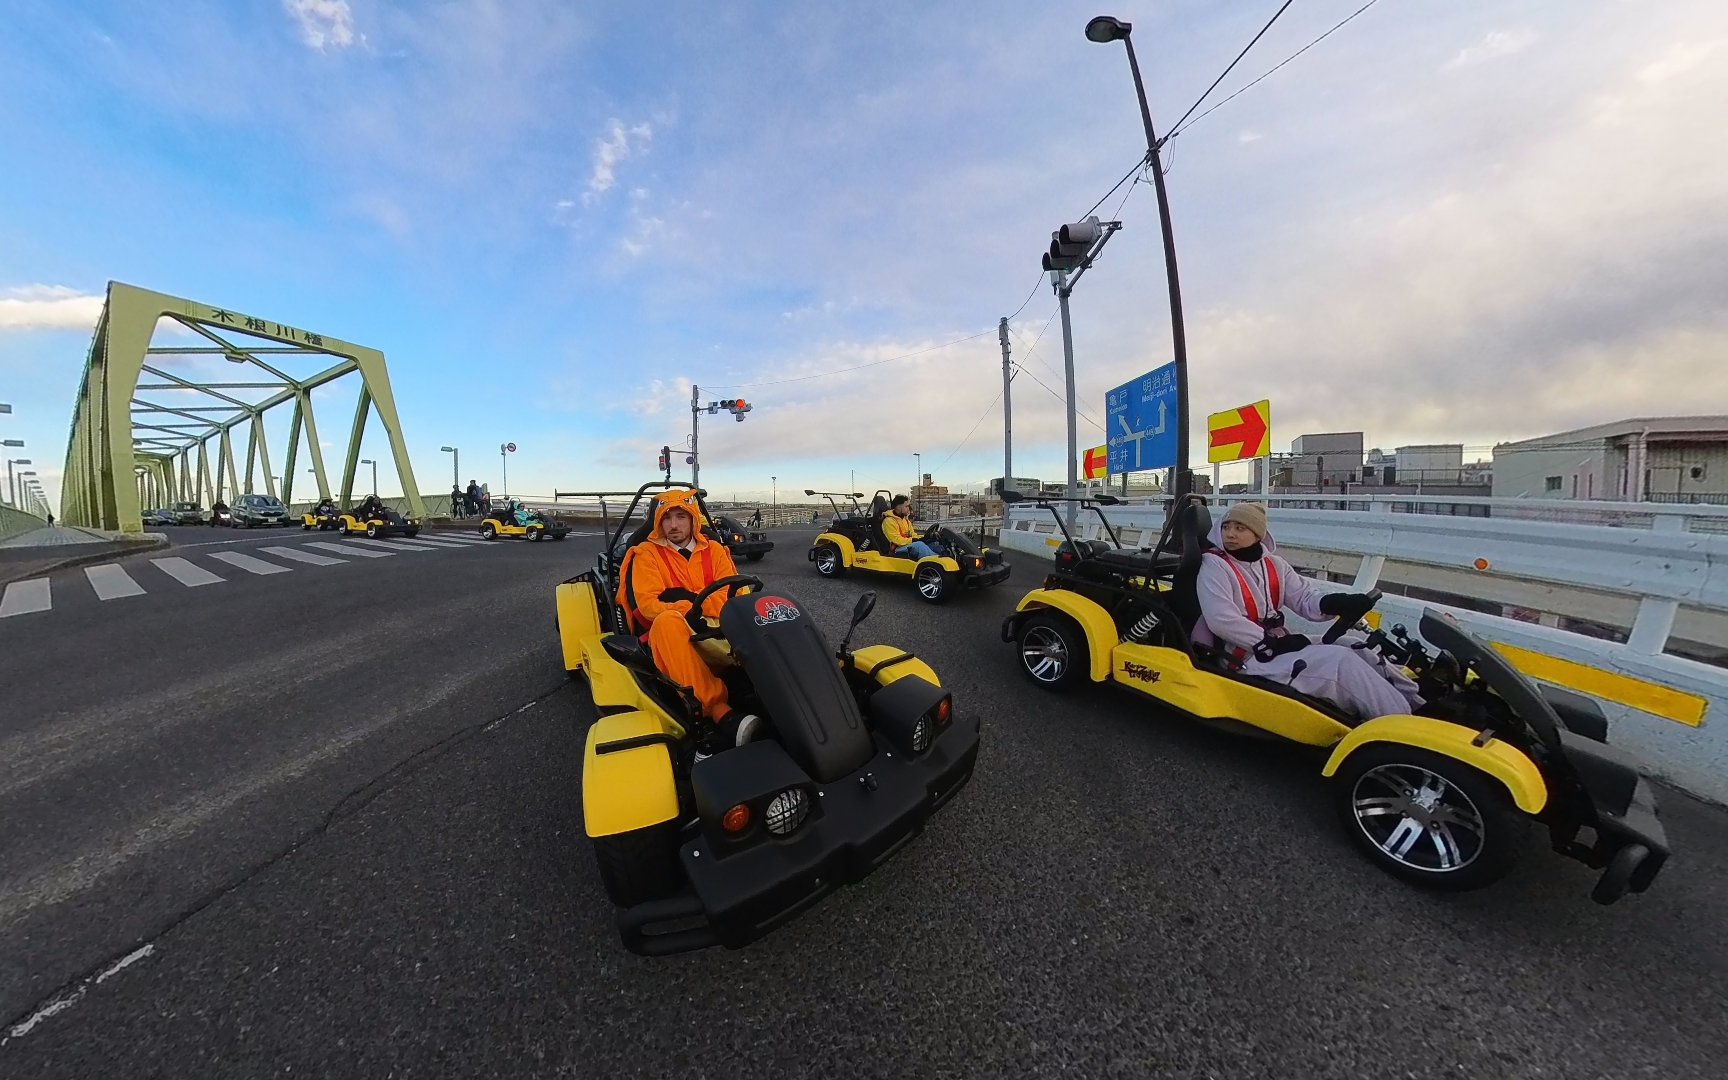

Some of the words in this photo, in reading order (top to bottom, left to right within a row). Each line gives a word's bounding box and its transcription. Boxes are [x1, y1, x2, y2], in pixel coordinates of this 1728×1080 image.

[211, 309, 323, 347] 木根川橋
[1110, 448, 1129, 463] 平井
